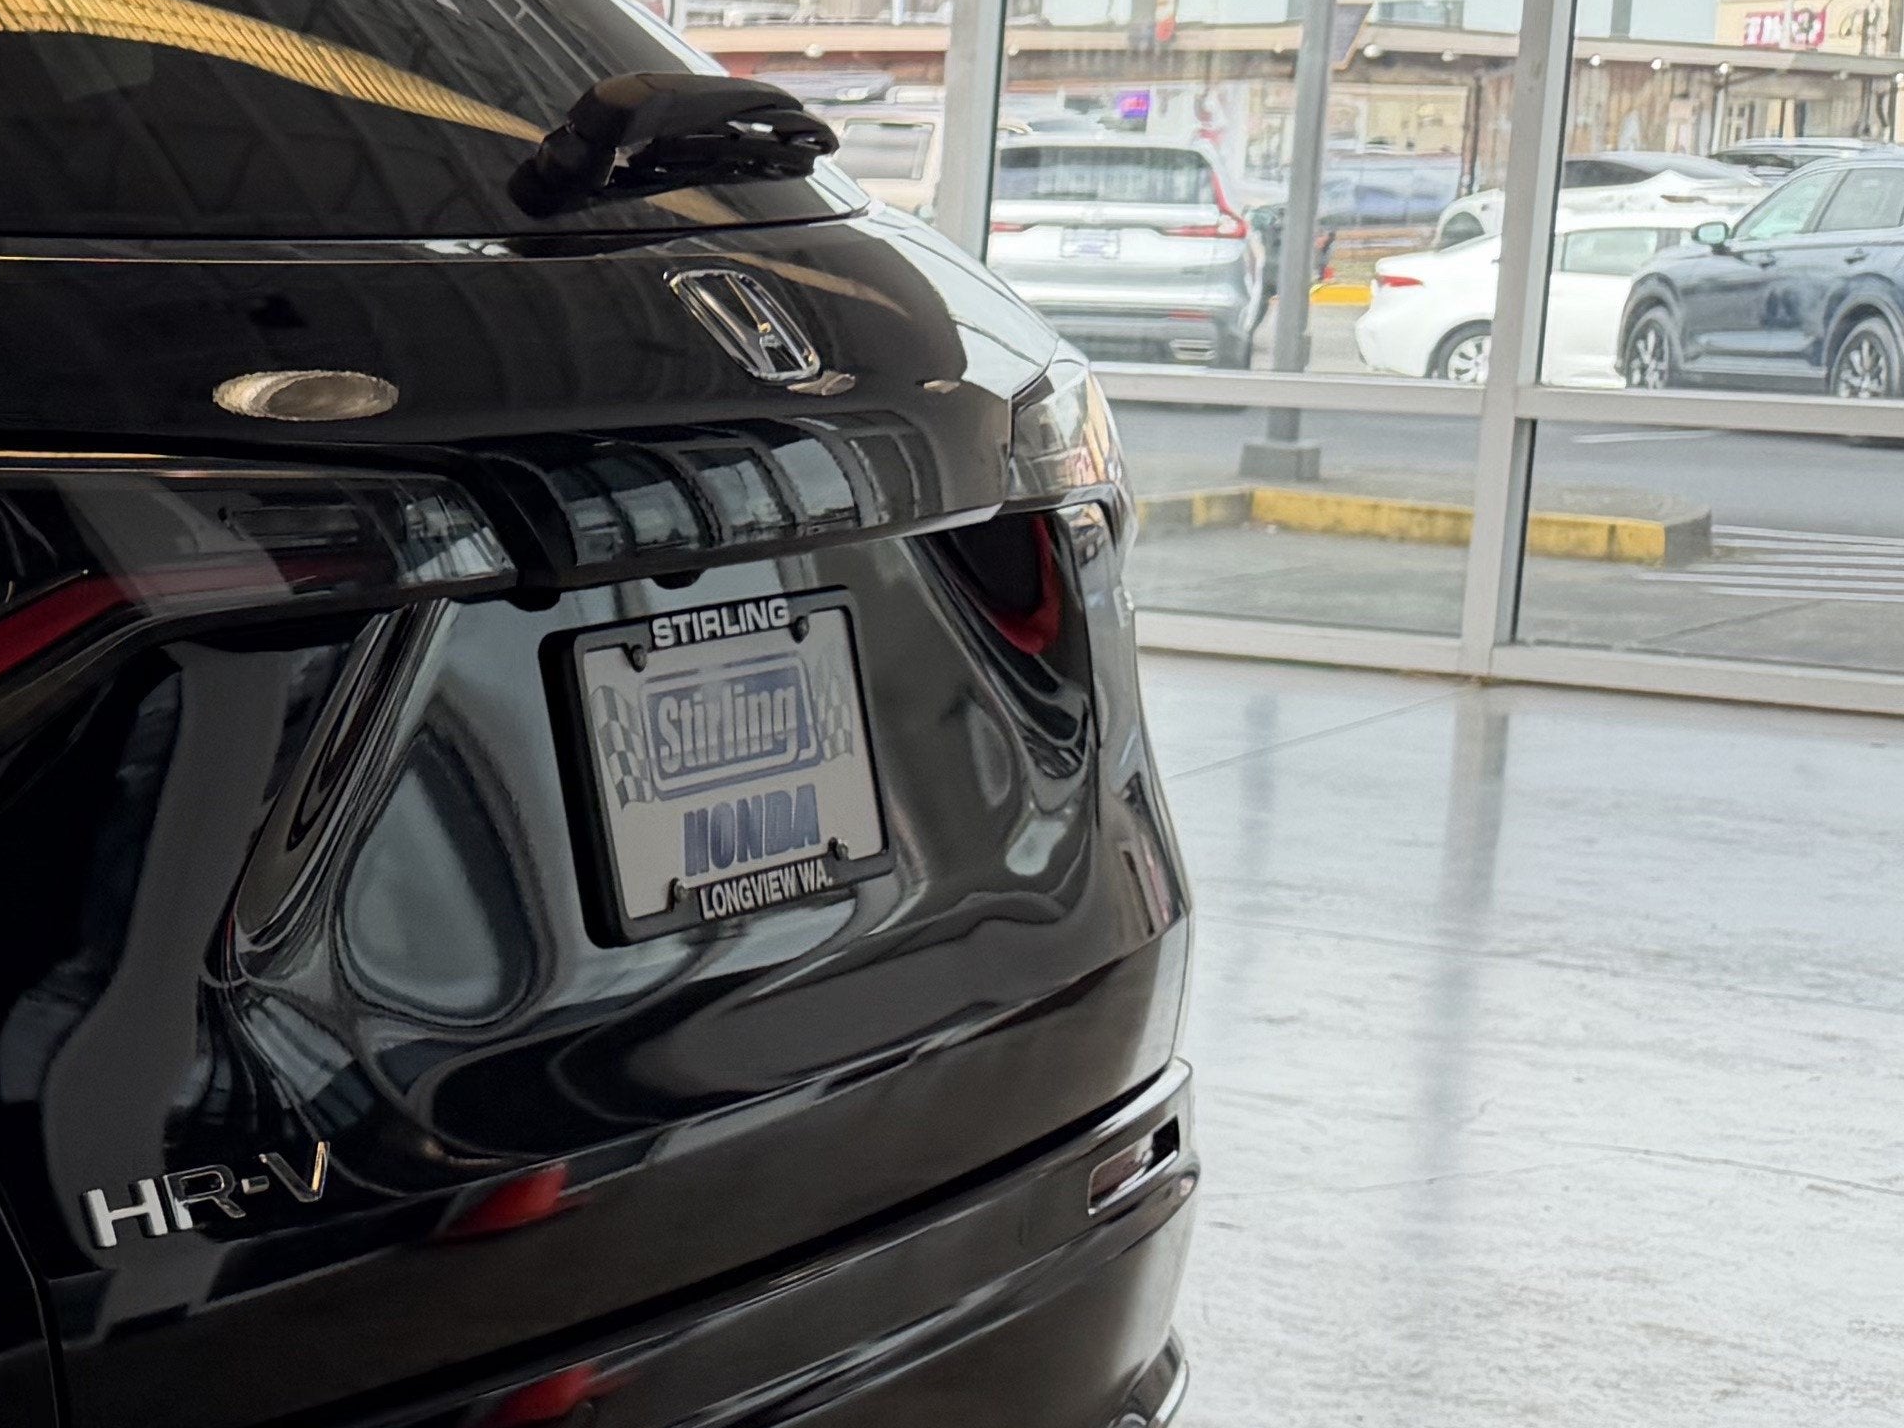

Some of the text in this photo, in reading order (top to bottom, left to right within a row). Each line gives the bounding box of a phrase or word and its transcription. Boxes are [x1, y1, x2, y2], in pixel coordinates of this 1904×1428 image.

[652, 598, 791, 647] STIRLING
[657, 683, 799, 772] Stirling
[683, 784, 820, 877] HONDA
[699, 861, 833, 920] LONGVIEW WA.
[84, 1141, 330, 1248] HR-V
